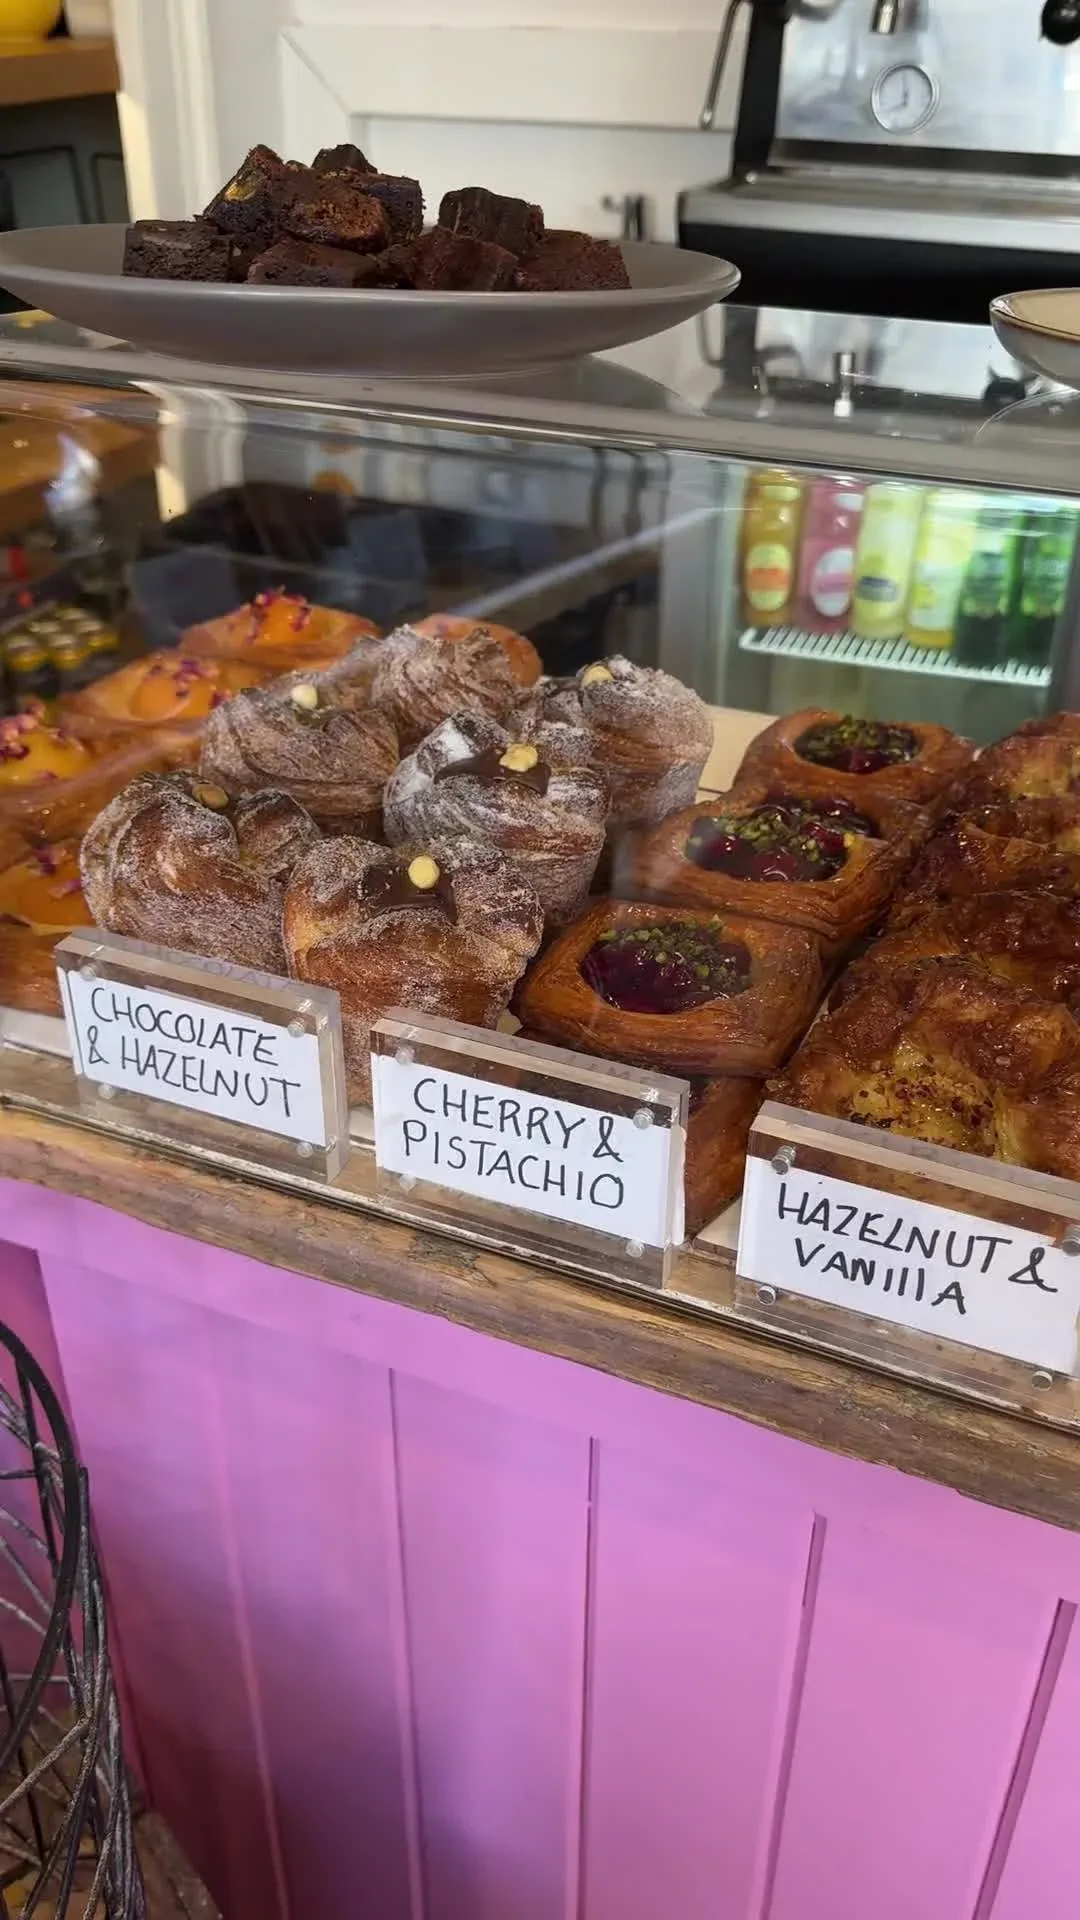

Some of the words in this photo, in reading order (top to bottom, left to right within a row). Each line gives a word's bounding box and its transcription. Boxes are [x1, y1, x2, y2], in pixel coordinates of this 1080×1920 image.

[91, 986, 279, 1066] CHOCOLATE
[88, 1025, 110, 1066] &
[121, 1035, 301, 1118] HAZELNUT
[403, 1120, 624, 1209] PISTACHIO
[414, 1078, 586, 1149] CHERRY
[592, 1115, 624, 1163] &
[778, 1182, 1013, 1274] HAZELNUT
[1007, 1246, 1058, 1293] &
